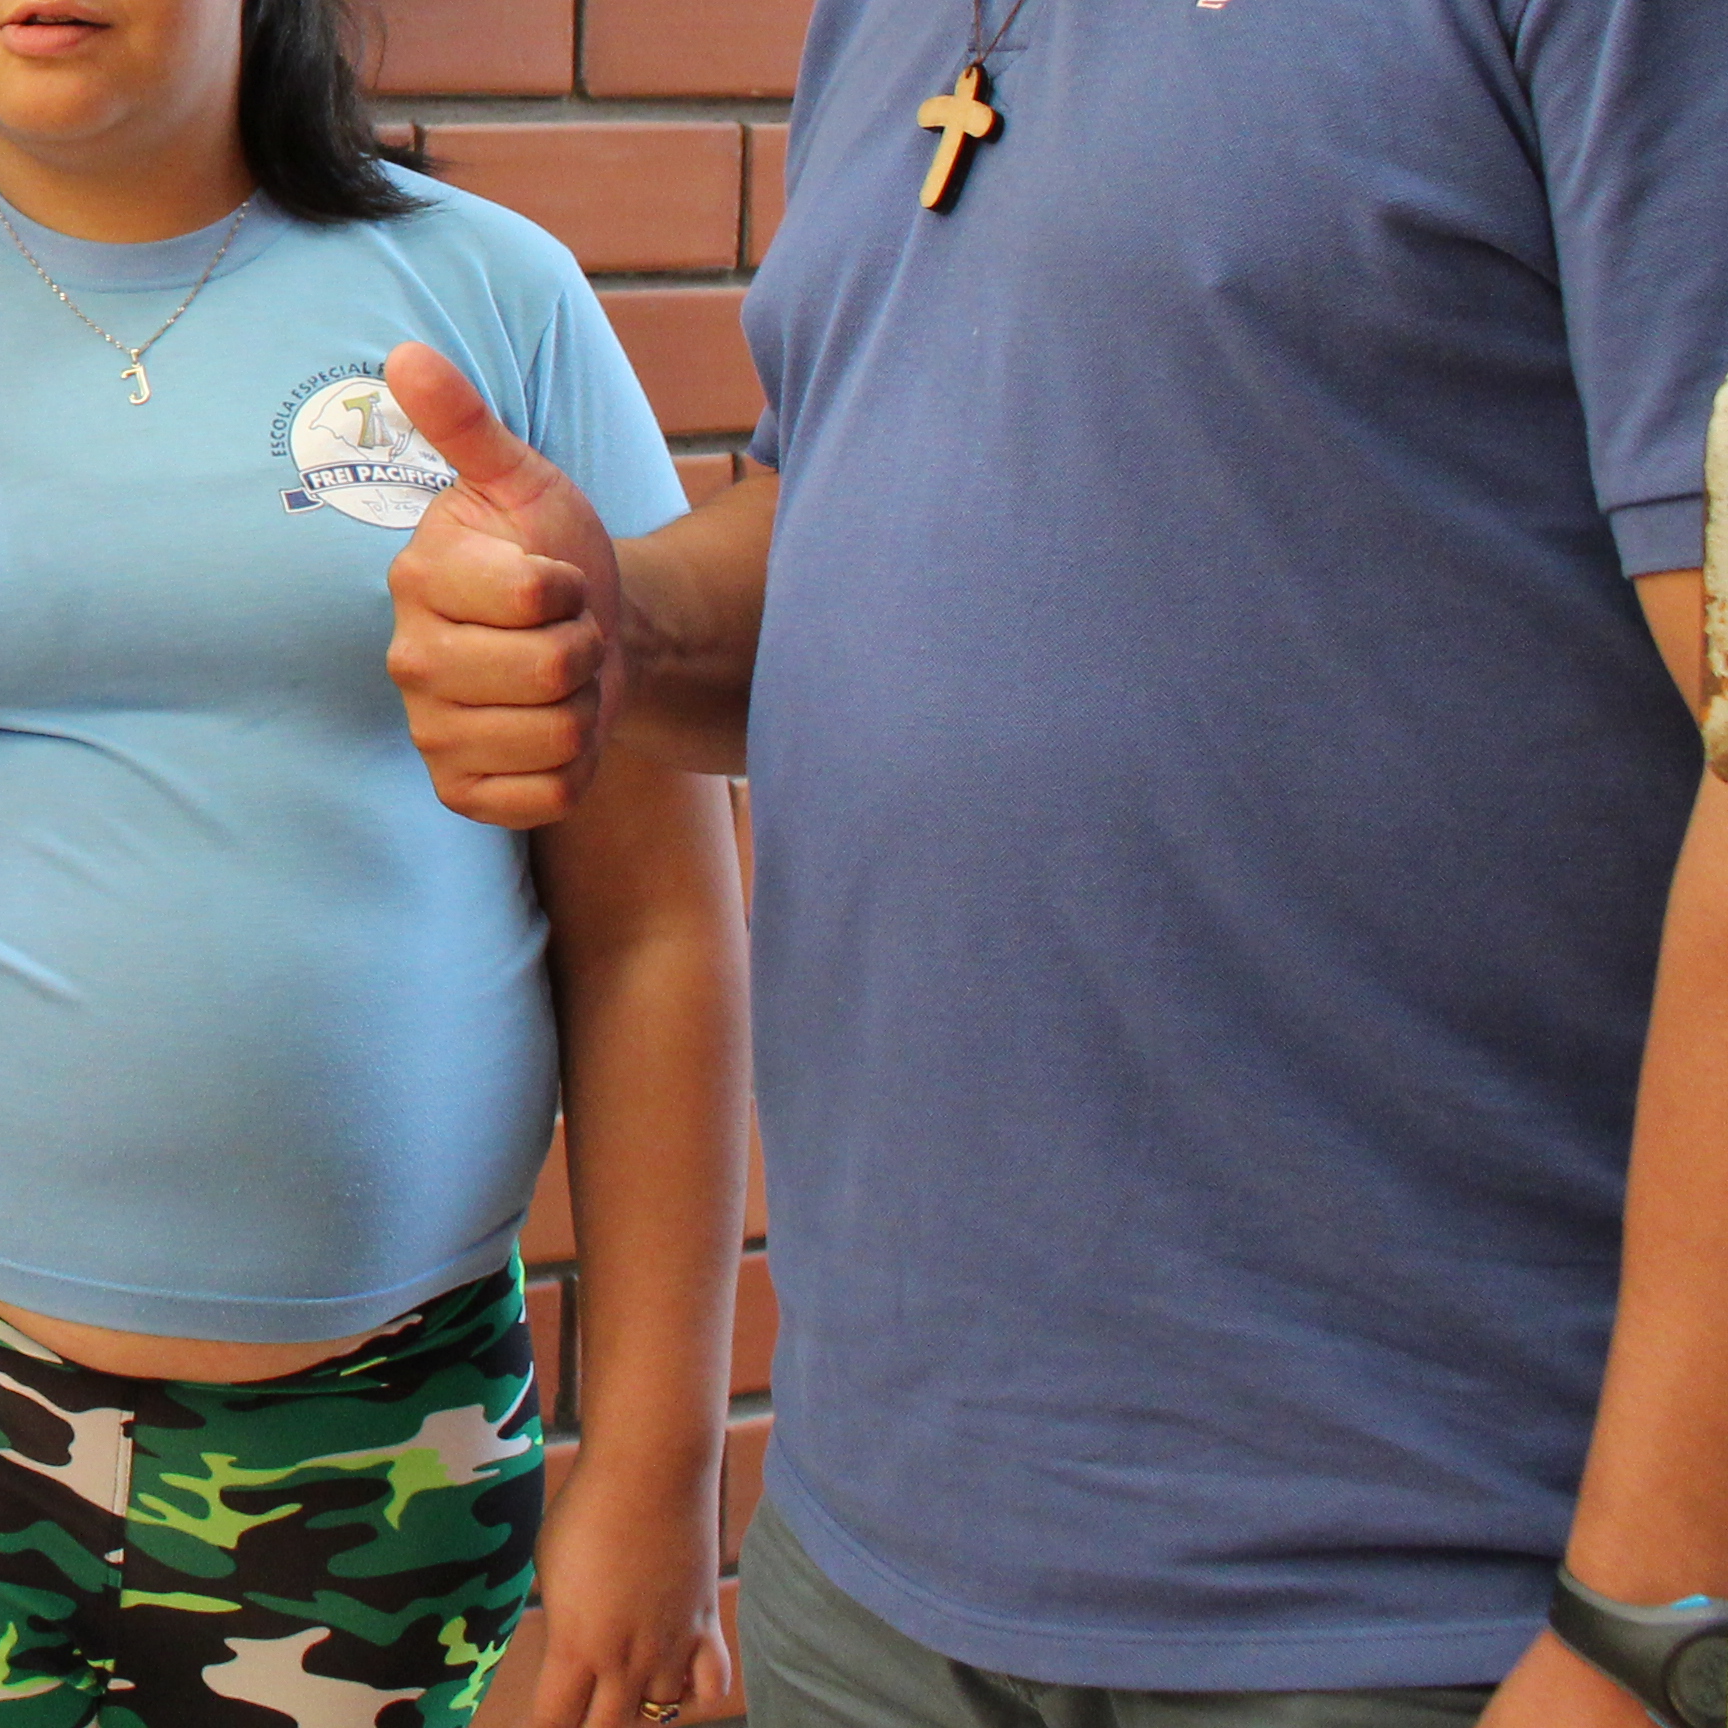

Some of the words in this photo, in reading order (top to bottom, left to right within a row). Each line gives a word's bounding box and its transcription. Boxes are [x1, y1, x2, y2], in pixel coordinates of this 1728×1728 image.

[271, 401, 297, 457] ESCOLA
[295, 361, 371, 400] ESPECIAL
[310, 467, 355, 488] FREI
[357, 465, 452, 491] PACÍFICO
